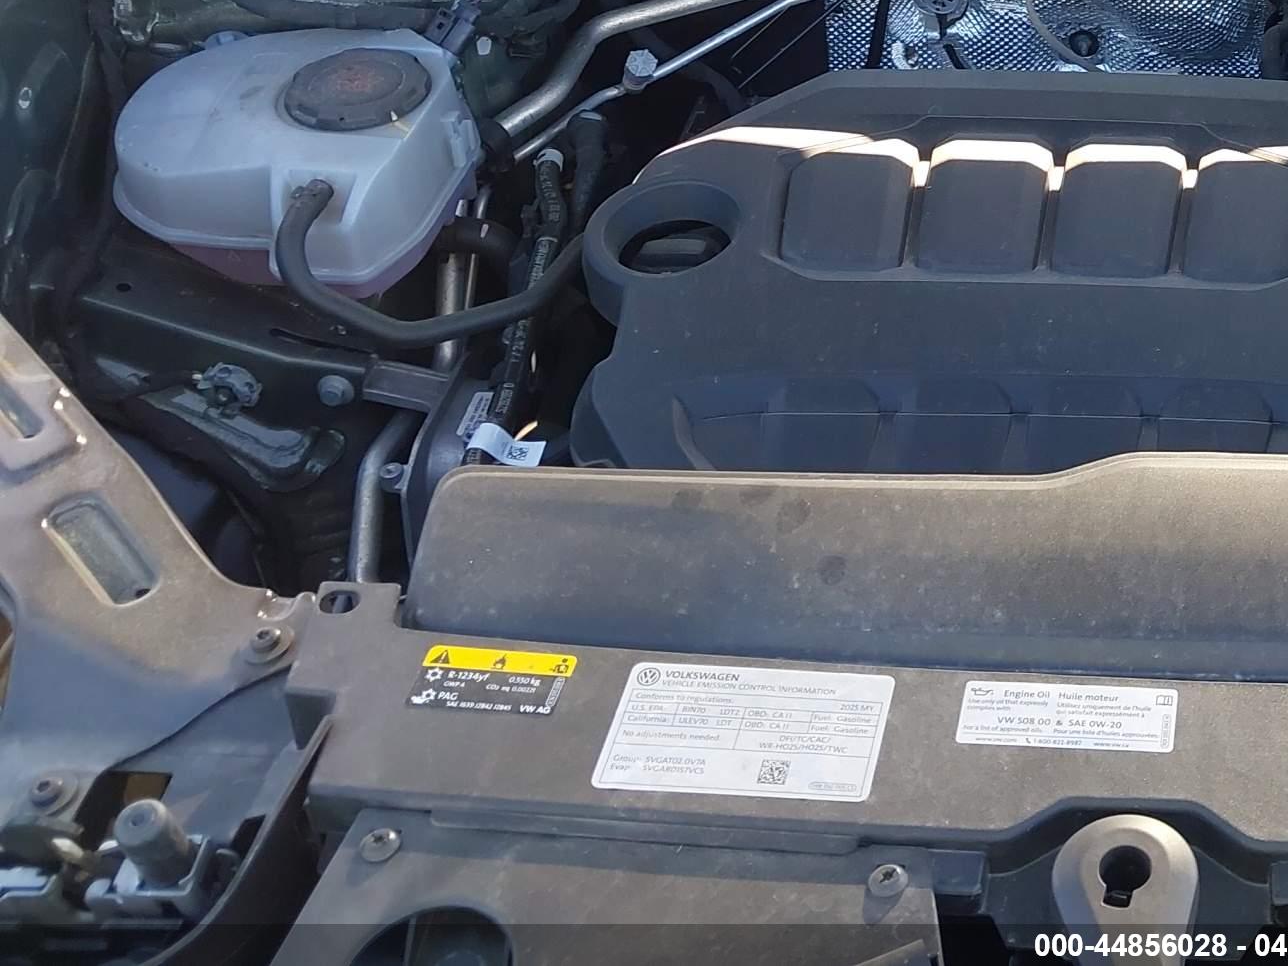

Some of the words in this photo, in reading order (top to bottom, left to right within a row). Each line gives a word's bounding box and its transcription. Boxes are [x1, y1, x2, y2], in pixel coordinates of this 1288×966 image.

[448, 671, 490, 682] R-1234yf
[530, 676, 541, 686] kg
[665, 670, 740, 681] VOLKSWAGEN
[697, 681, 736, 689] EMISSION
[738, 683, 775, 691] CONTROL
[778, 684, 837, 695] INFORMATION
[437, 691, 459, 700] PAG
[636, 693, 674, 701] Conforms
[1004, 690, 1035, 699] Engine
[1059, 692, 1083, 700] Huile
[1085, 694, 1118, 702] moteur
[520, 705, 536, 713] VW
[536, 706, 551, 714] AG
[836, 715, 872, 723] Gasoline
[997, 716, 1015, 724] VW
[1017, 717, 1035, 725] 508
[1089, 720, 1122, 729] 0W-20
[833, 726, 869, 734] Gasoline
[635, 731, 687, 740] adjustments
